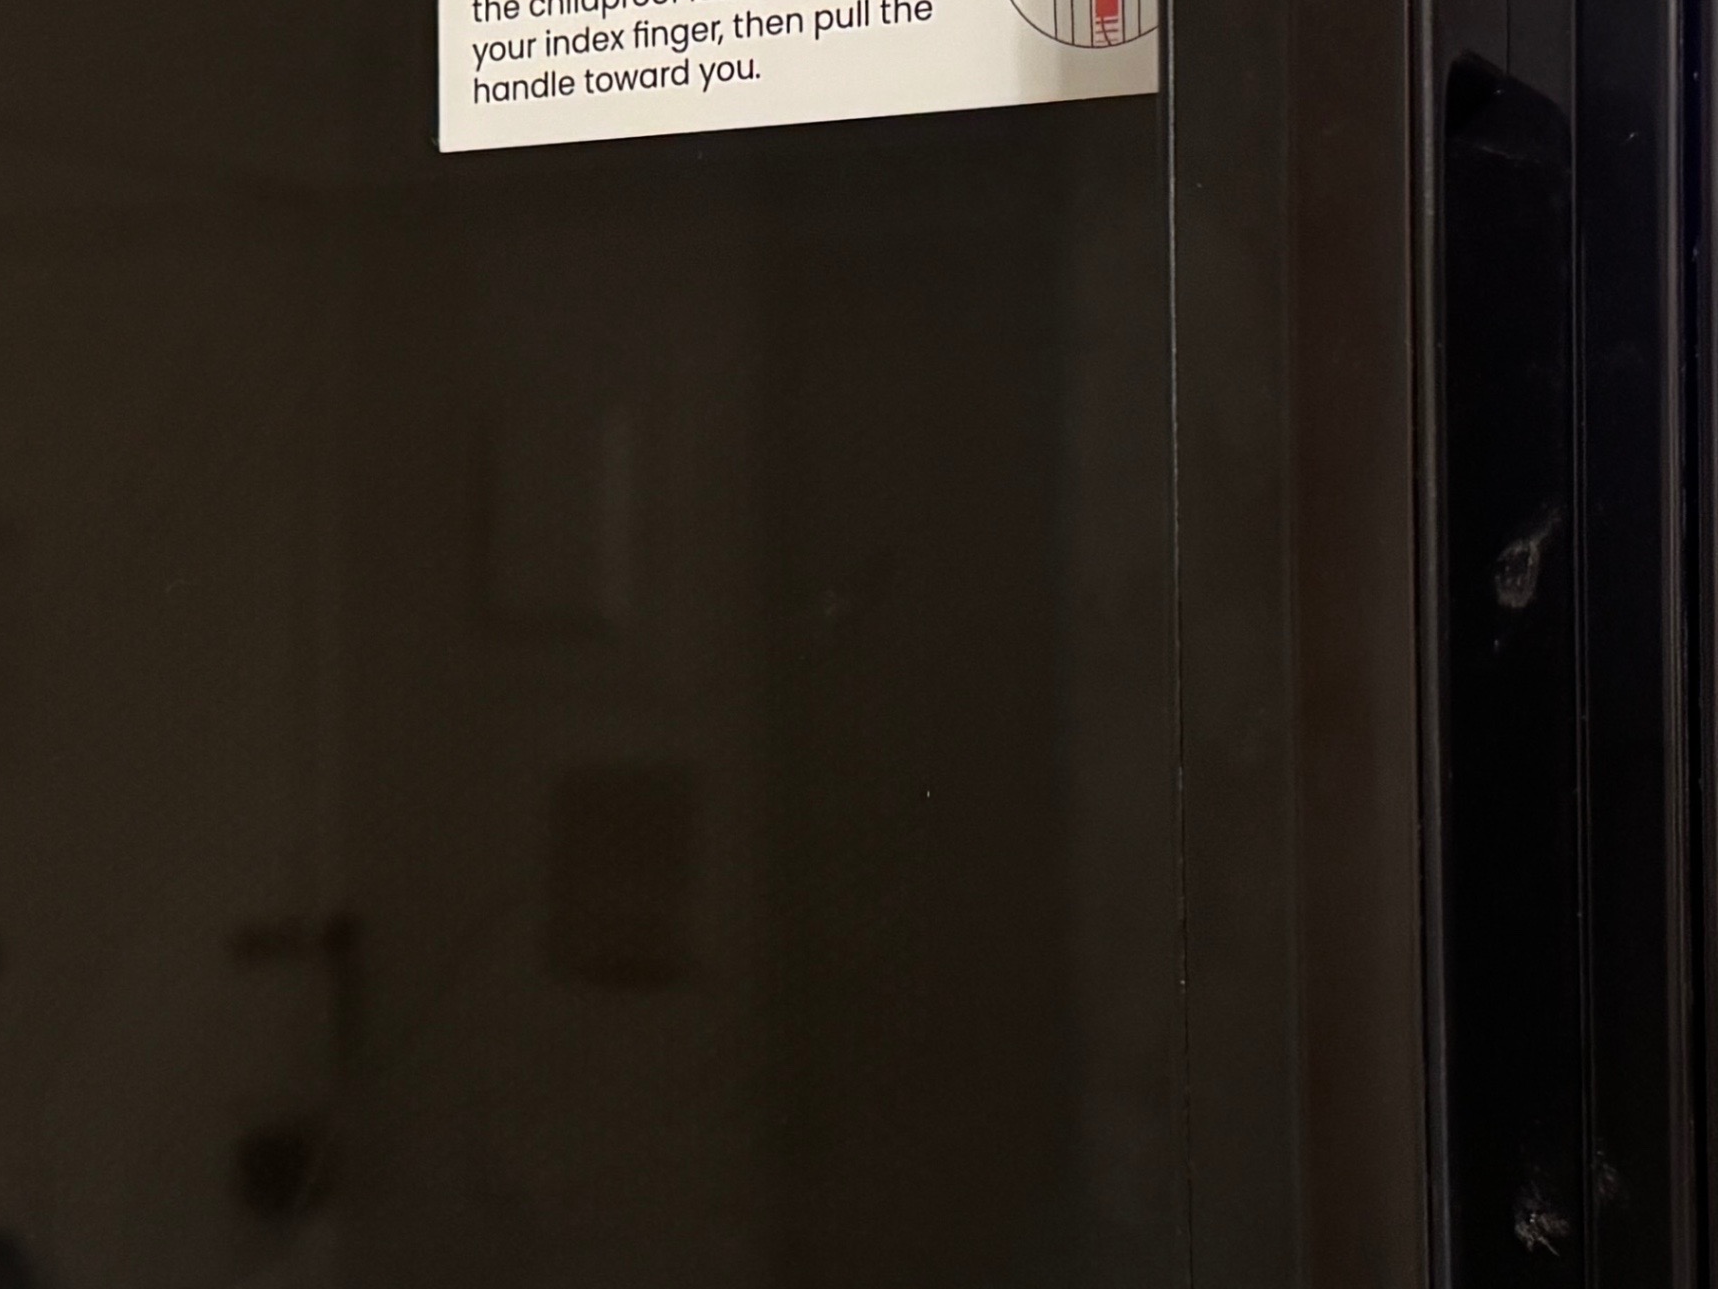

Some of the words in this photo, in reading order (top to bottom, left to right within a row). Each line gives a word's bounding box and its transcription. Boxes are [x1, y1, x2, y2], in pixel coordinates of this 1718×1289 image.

[472, 38, 536, 72] your
[546, 27, 624, 57] index
[633, 20, 723, 53] finger,
[733, 11, 803, 38] then
[815, 0, 869, 40] pull
[474, 71, 575, 103] handle
[585, 58, 689, 94] toward
[699, 59, 760, 92] you.
